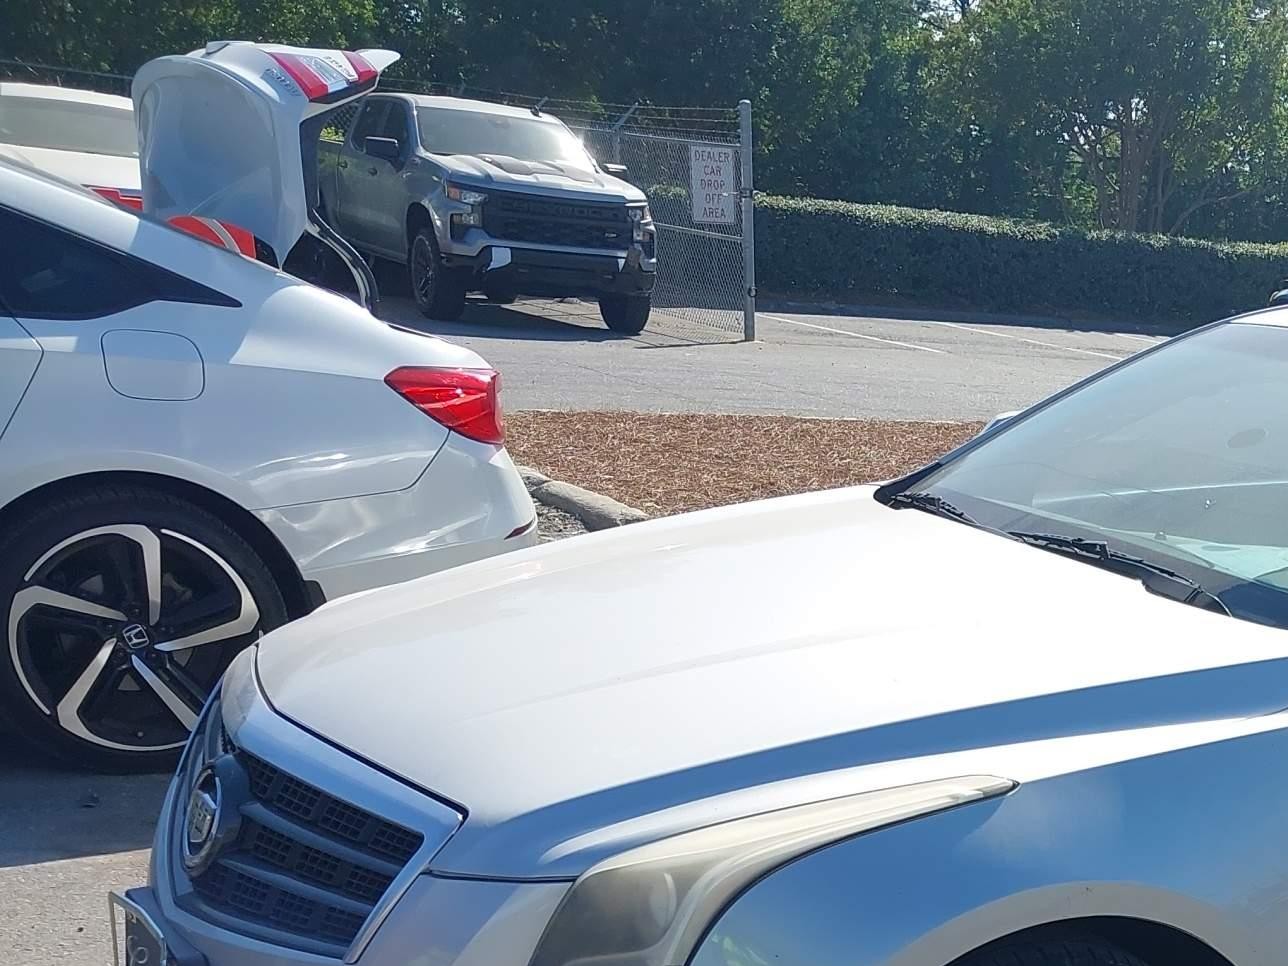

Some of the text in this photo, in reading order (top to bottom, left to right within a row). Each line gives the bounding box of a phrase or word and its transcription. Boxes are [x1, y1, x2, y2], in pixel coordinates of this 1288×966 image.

[694, 150, 730, 163] DEALER
[703, 164, 722, 177] CAR
[700, 178, 726, 191] DROP
[705, 193, 723, 206] OFF
[702, 206, 726, 219] AREA
